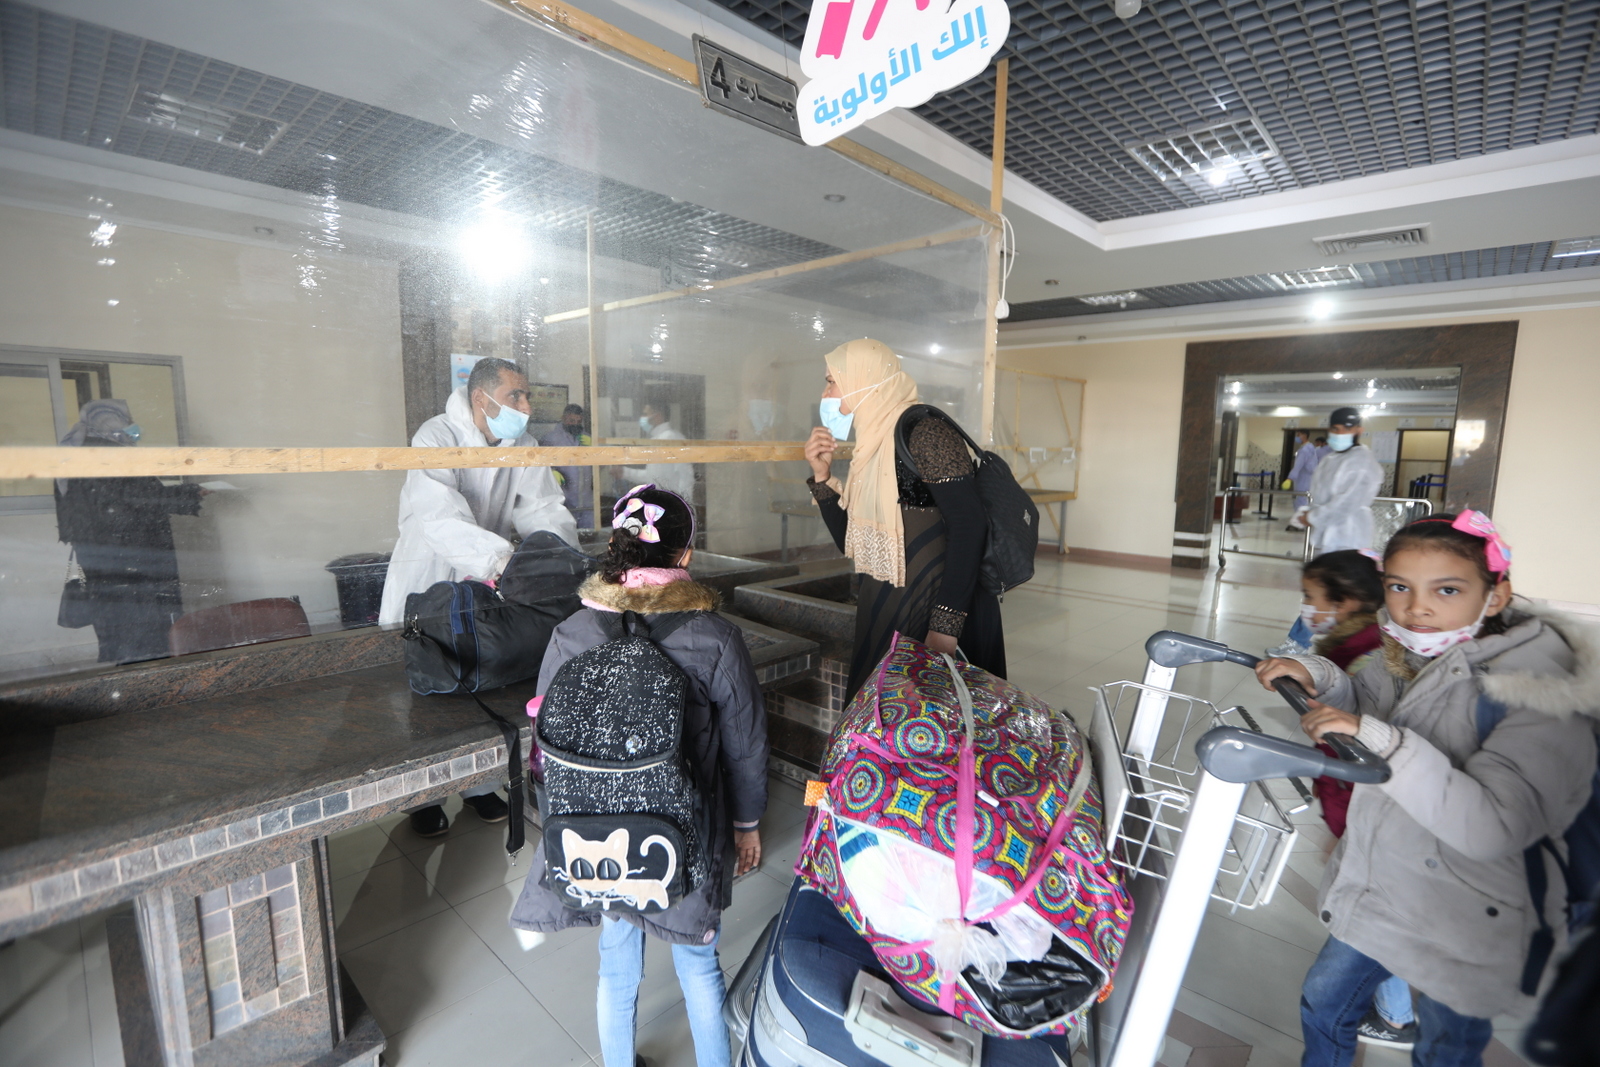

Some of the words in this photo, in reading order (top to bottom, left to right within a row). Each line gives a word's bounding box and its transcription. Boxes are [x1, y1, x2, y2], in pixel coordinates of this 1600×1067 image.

[931, 5, 990, 61] إلك
[709, 56, 731, 100] 4
[813, 42, 922, 127] الأولوية
